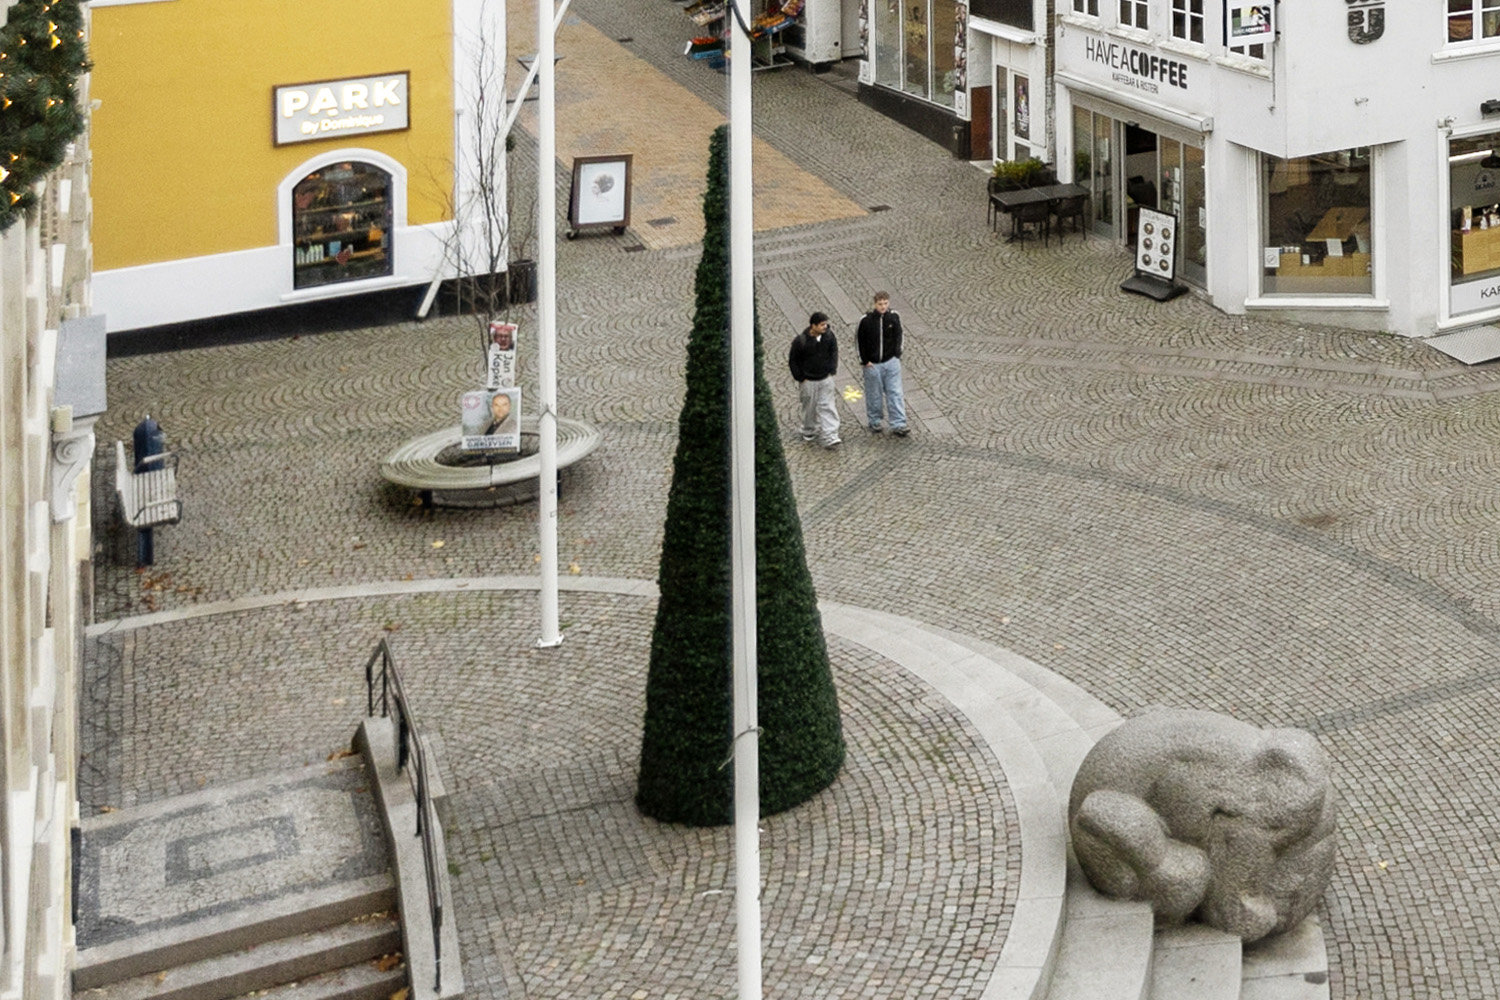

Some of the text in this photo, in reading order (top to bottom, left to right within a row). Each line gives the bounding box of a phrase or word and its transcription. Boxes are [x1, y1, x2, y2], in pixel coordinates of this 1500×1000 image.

[282, 79, 401, 119] PARK
[301, 114, 385, 135] By Dominique
[503, 353, 513, 373] Jan
